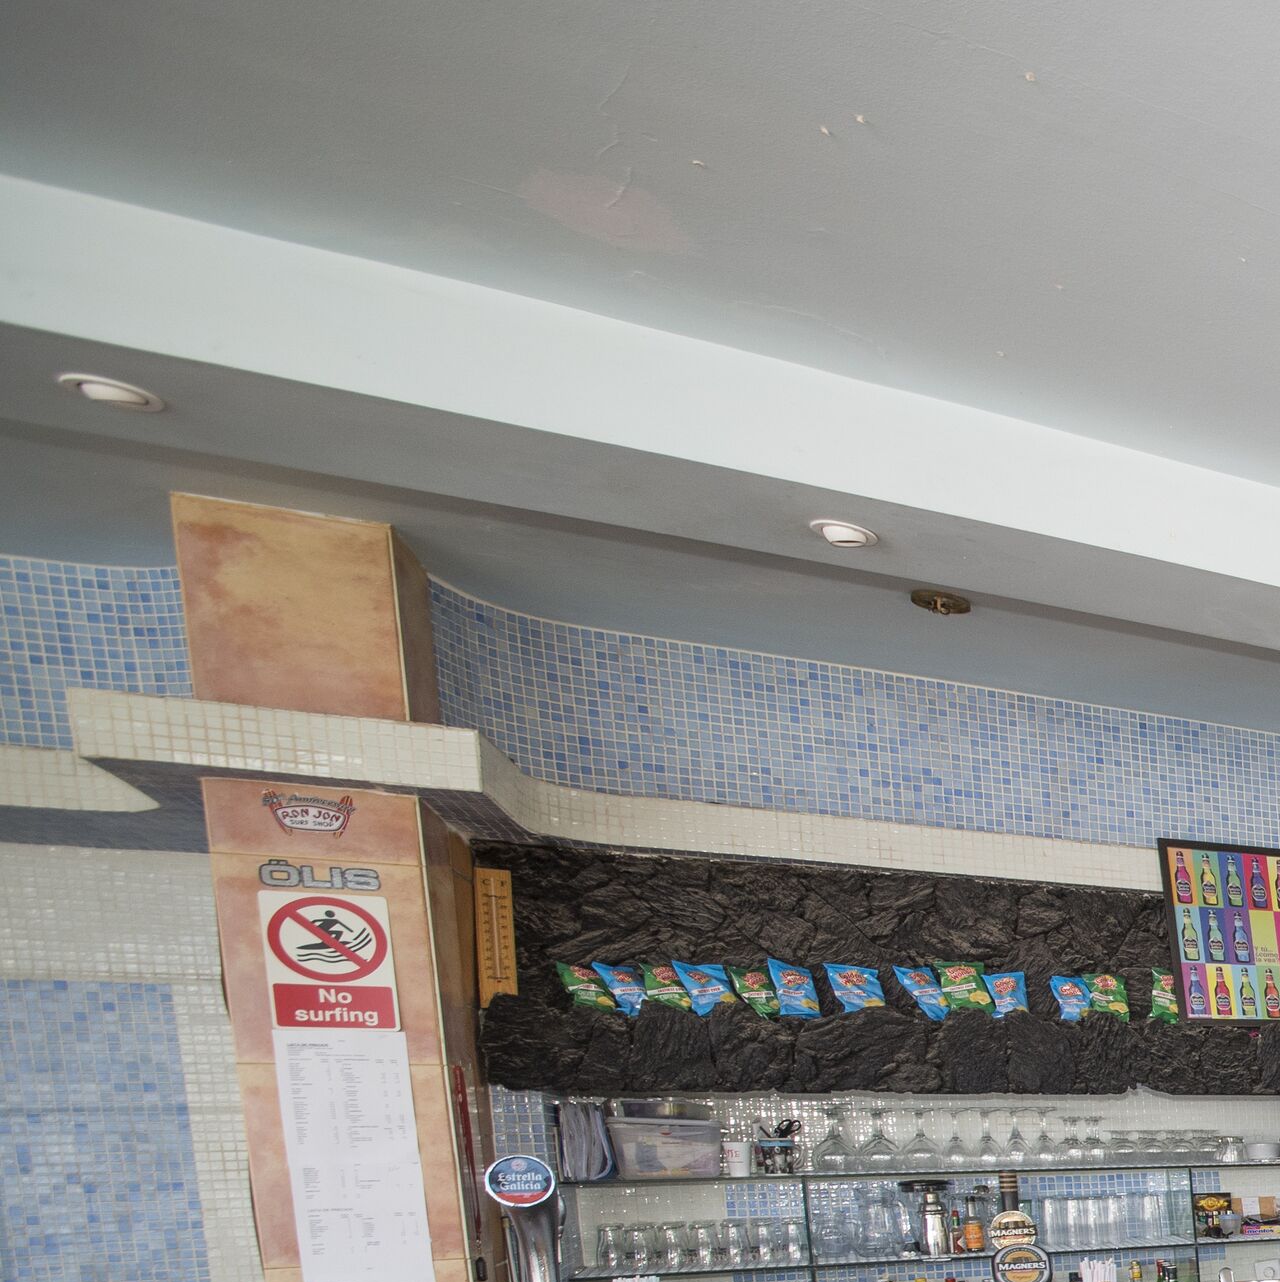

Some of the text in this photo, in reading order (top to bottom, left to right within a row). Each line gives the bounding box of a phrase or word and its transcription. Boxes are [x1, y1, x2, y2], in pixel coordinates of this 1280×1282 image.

[282, 808, 341, 823] RON JON
[319, 988, 353, 1004] No
[294, 1007, 379, 1026] surfing
[497, 1171, 543, 1182] Estrella
[500, 1180, 542, 1192] Galicia
[991, 1227, 1036, 1238] MAGNERS
[998, 1261, 1047, 1272] MAGNERS
